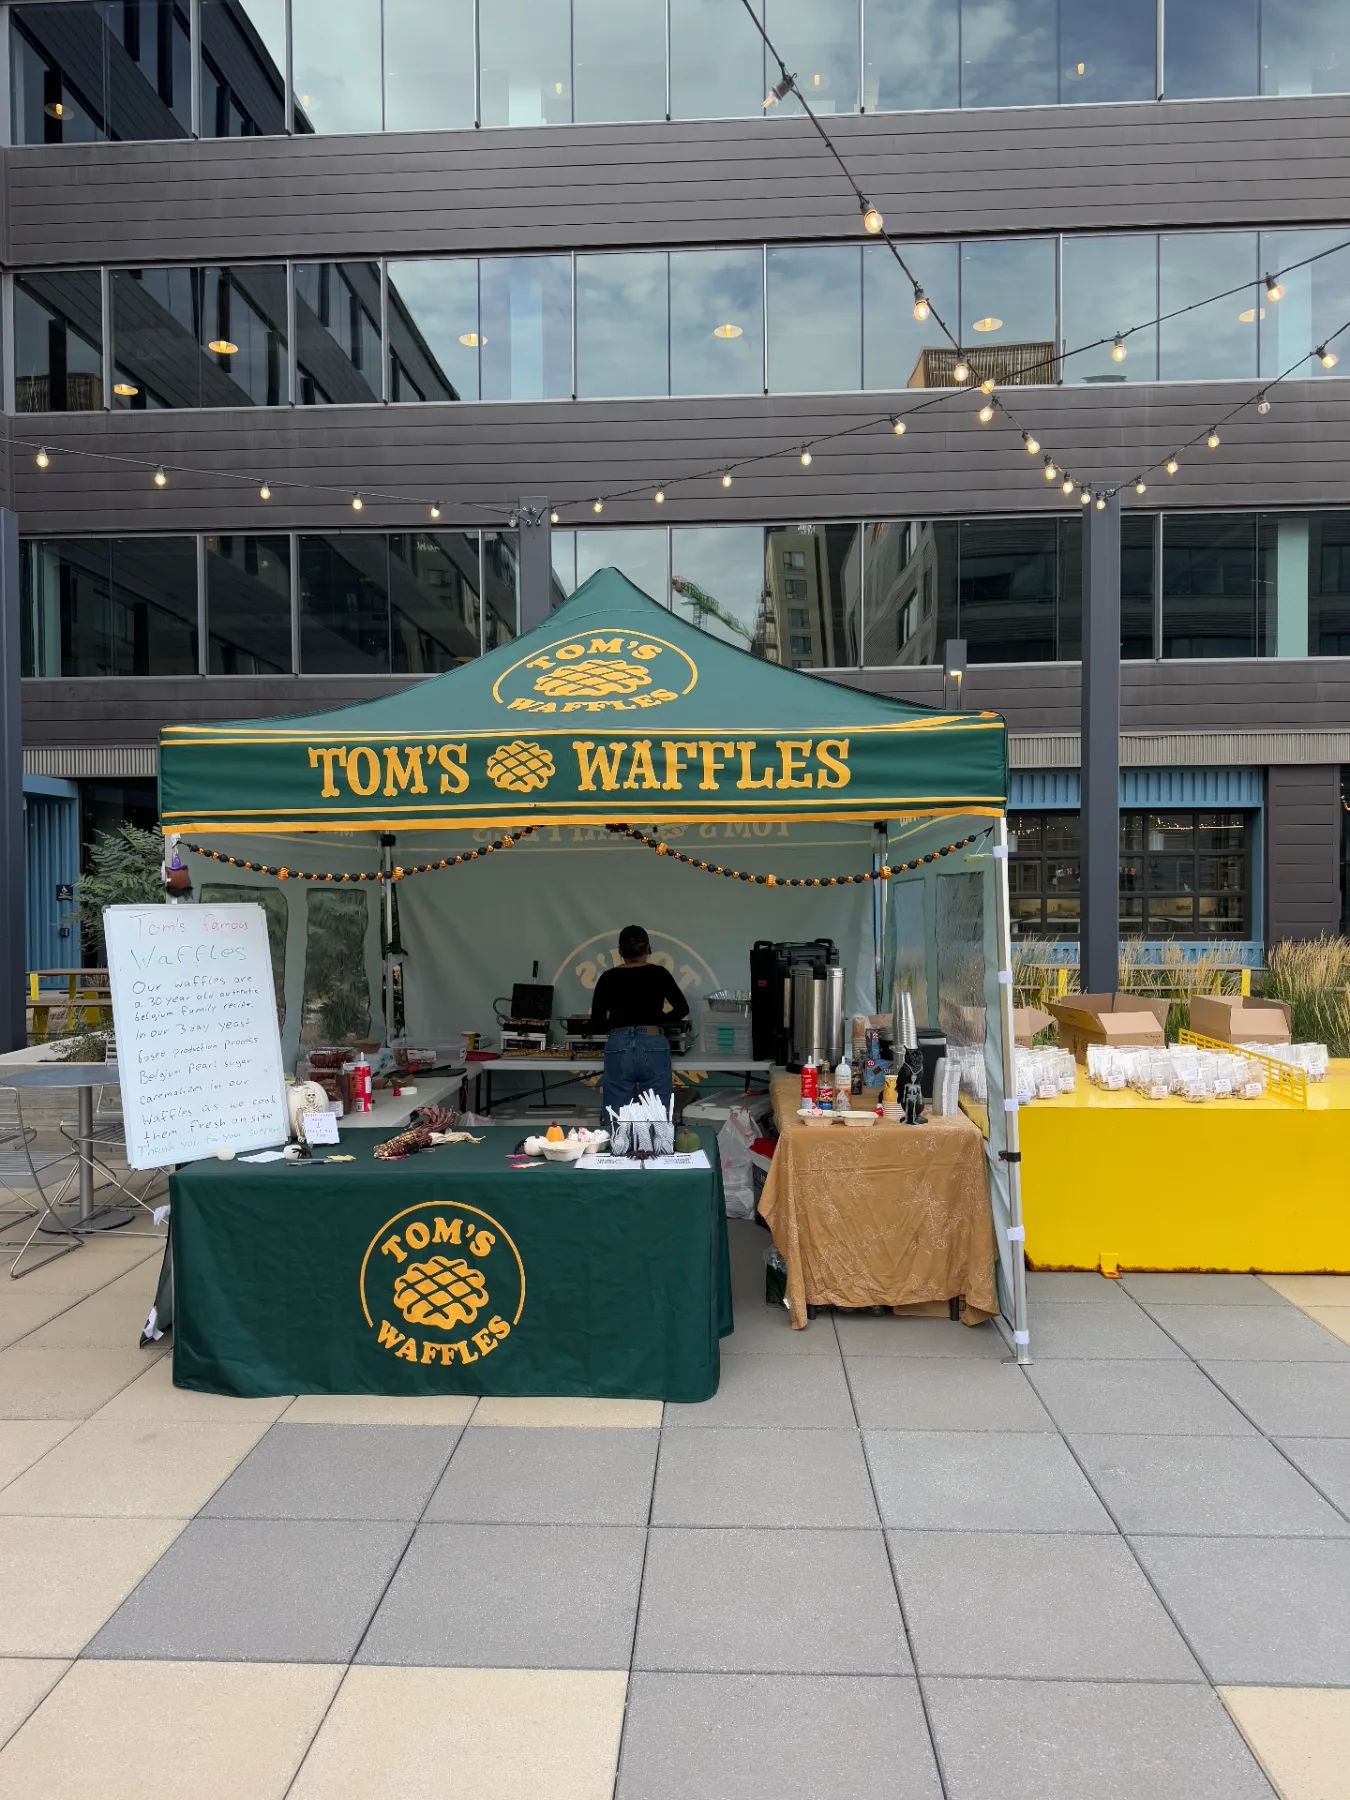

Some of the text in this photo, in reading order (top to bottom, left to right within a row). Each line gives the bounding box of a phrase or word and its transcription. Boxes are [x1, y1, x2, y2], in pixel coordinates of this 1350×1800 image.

[526, 637, 663, 671] TOM'S
[507, 688, 680, 714] WAFFLES
[307, 738, 852, 798] TOM'S WAFFLES
[129, 911, 186, 938] Tom's
[132, 980, 162, 995] Our
[233, 976, 253, 984] are
[134, 1001, 143, 1009] a
[147, 996, 163, 1007] 30
[165, 995, 190, 1006] year
[196, 992, 215, 1000] old
[149, 1028, 170, 1039] our
[175, 1023, 187, 1035] 3
[189, 1023, 210, 1034] day
[217, 1018, 252, 1033] yeast
[138, 1037, 259, 1064] based production process
[139, 1069, 181, 1085] Belgium
[188, 1060, 218, 1075] pearl
[210, 1079, 222, 1090] in
[228, 1079, 250, 1087] our
[201, 1101, 219, 1113] as
[230, 1099, 245, 1109] we
[252, 1095, 278, 1106] cook
[143, 1128, 178, 1140] them
[189, 1119, 226, 1132] fresh
[137, 1140, 175, 1157] Thank
[180, 1139, 200, 1149] you
[204, 1134, 220, 1144] for
[381, 1217, 496, 1263] TOM'S
[377, 1314, 511, 1366] WAFFLES
